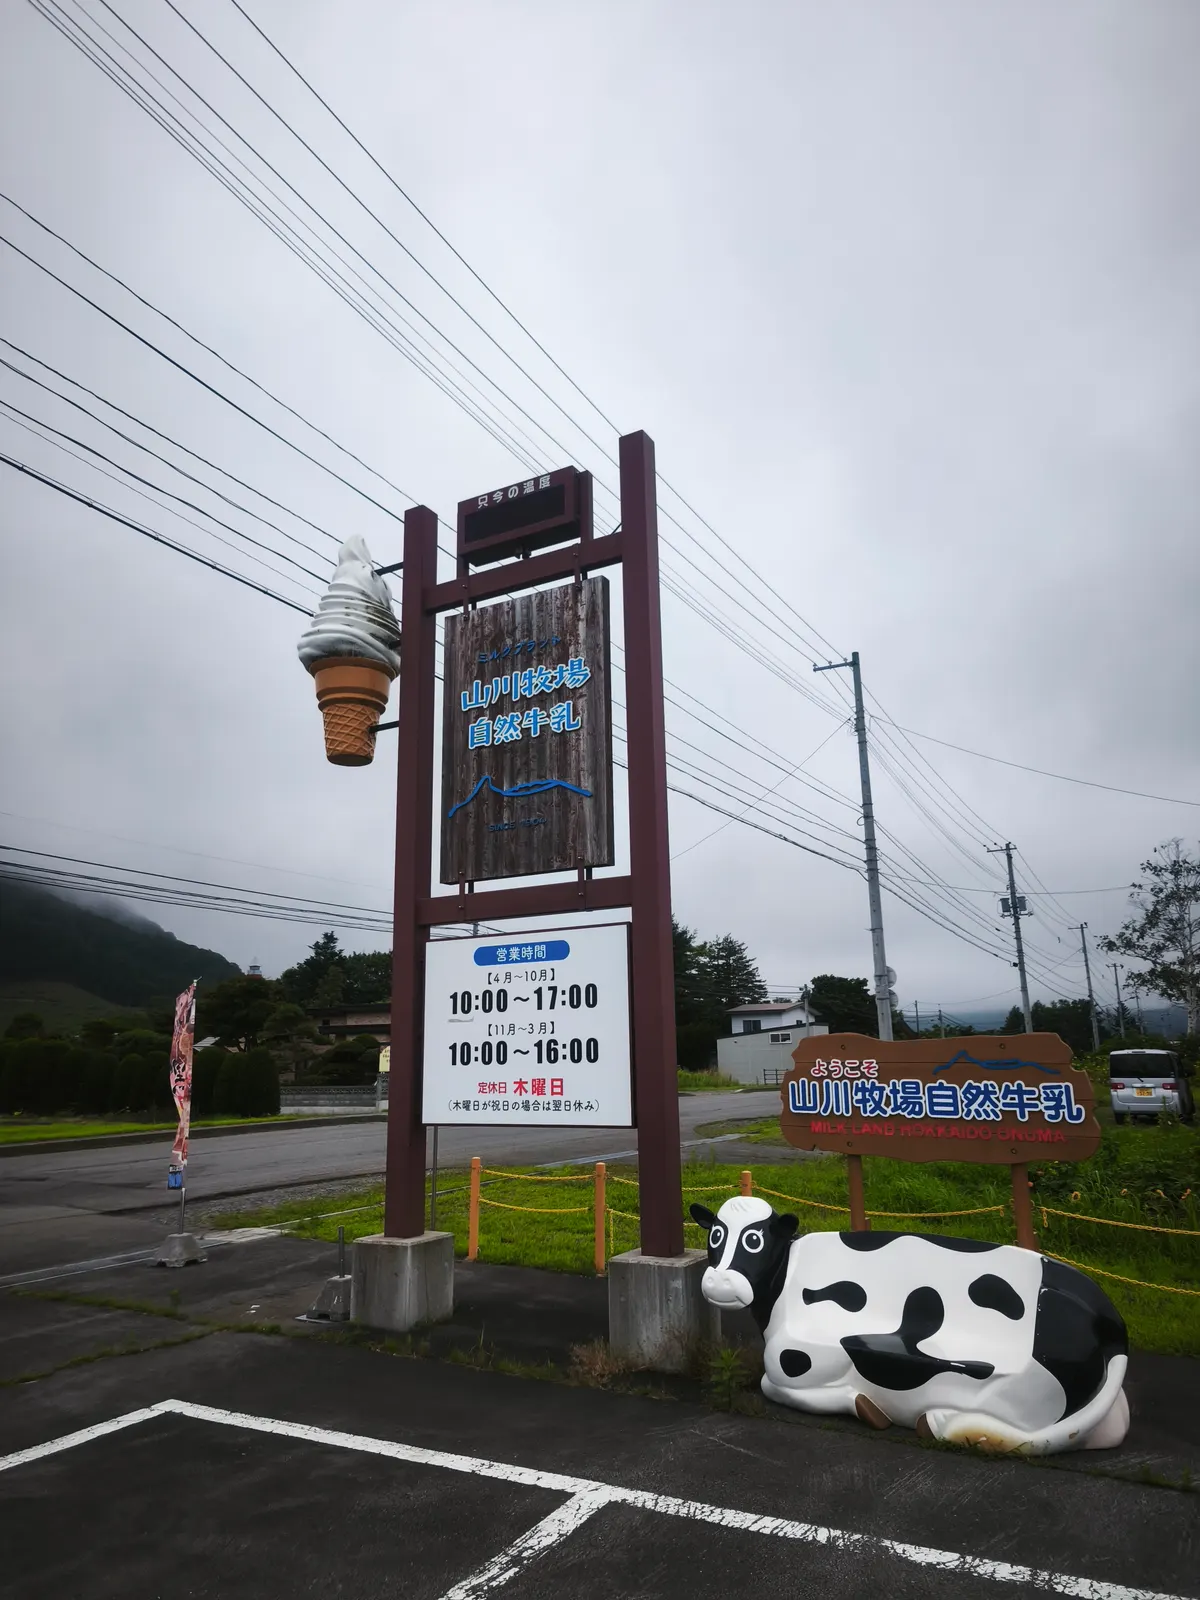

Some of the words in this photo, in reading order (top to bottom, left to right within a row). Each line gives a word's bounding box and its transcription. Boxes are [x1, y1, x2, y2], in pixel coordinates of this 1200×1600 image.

[477, 474, 551, 509] 只今の温度
[460, 657, 592, 713] 山川牧場
[467, 701, 582, 750] 自然牛乳
[496, 944, 547, 962] 営業時間
[810, 1058, 880, 1079] ようこそ
[477, 1081, 508, 1095] 定休日
[513, 1077, 565, 1097] 木曜日
[788, 1078, 1087, 1124] 山川牧場自然牛乳
[810, 1121, 846, 1135] MILK
[850, 1122, 896, 1136] LAND
[900, 1124, 993, 1141] HOKKAIDO
[997, 1128, 1067, 1143] ONUMA
